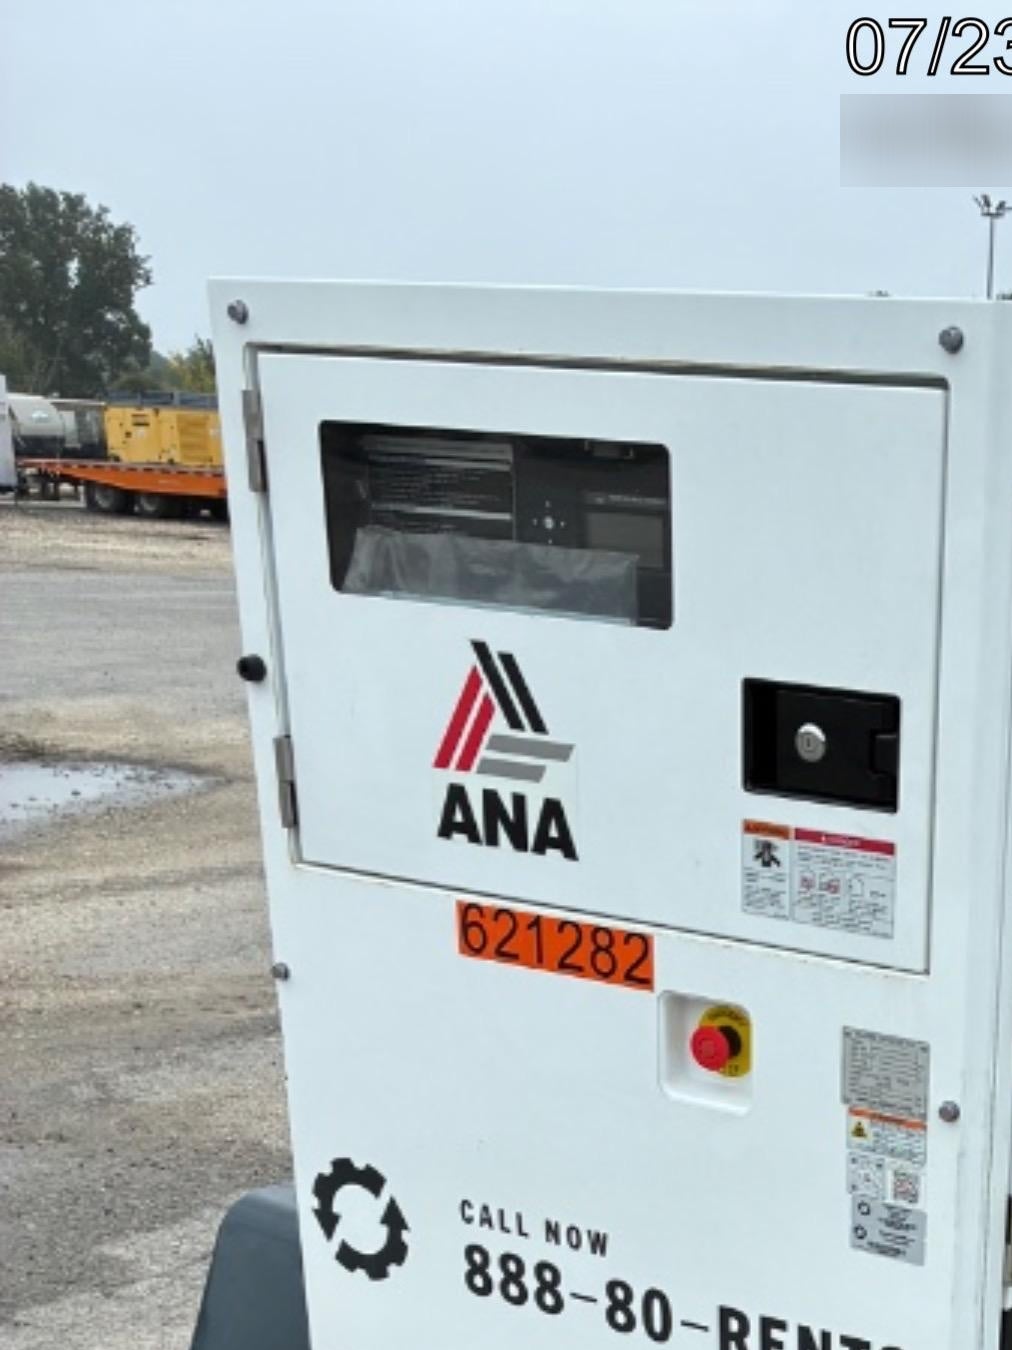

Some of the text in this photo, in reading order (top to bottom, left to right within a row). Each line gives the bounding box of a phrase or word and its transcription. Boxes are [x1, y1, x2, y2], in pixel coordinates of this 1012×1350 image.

[437, 782, 579, 862] ANA
[462, 902, 651, 984] 621282
[460, 1199, 610, 1259] CALL NOW
